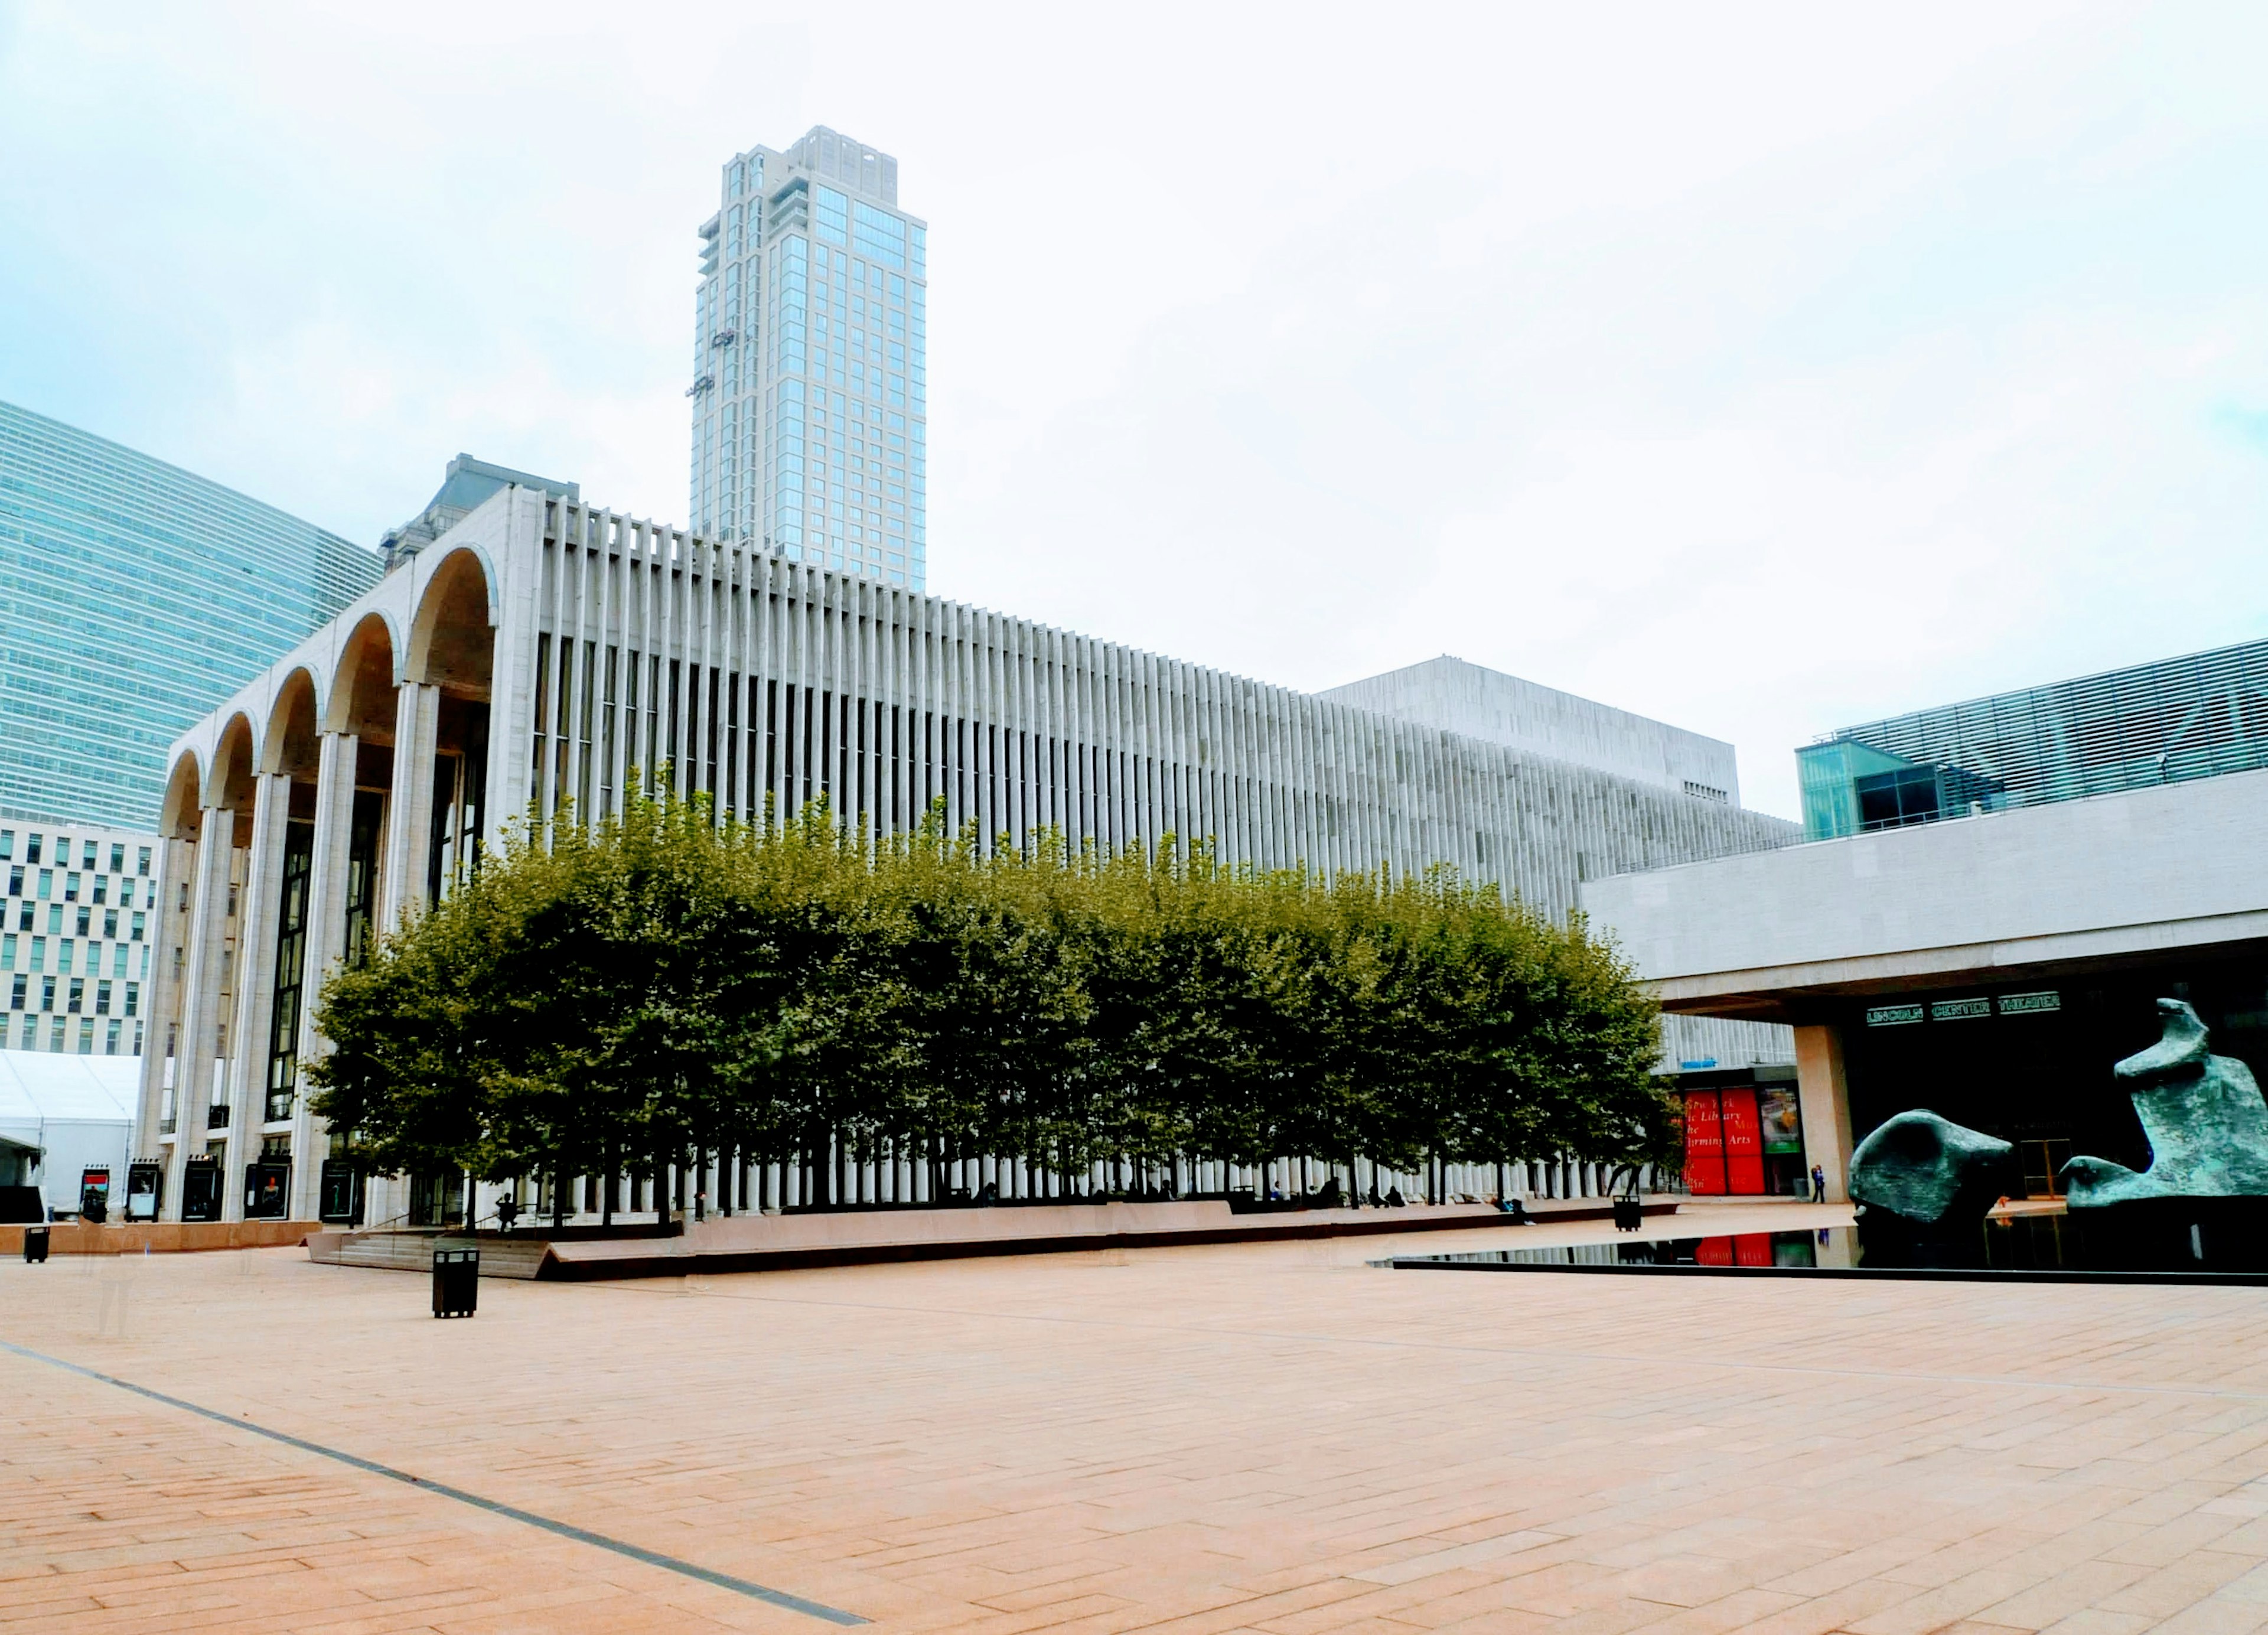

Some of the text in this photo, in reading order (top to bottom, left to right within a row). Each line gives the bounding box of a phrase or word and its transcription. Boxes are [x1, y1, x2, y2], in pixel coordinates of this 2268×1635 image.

[1866, 995, 2061, 1023] LINCOLN CENTER THEATER
[1701, 1110, 1742, 1122] Libary
[1728, 1134, 1751, 1145] Arts
